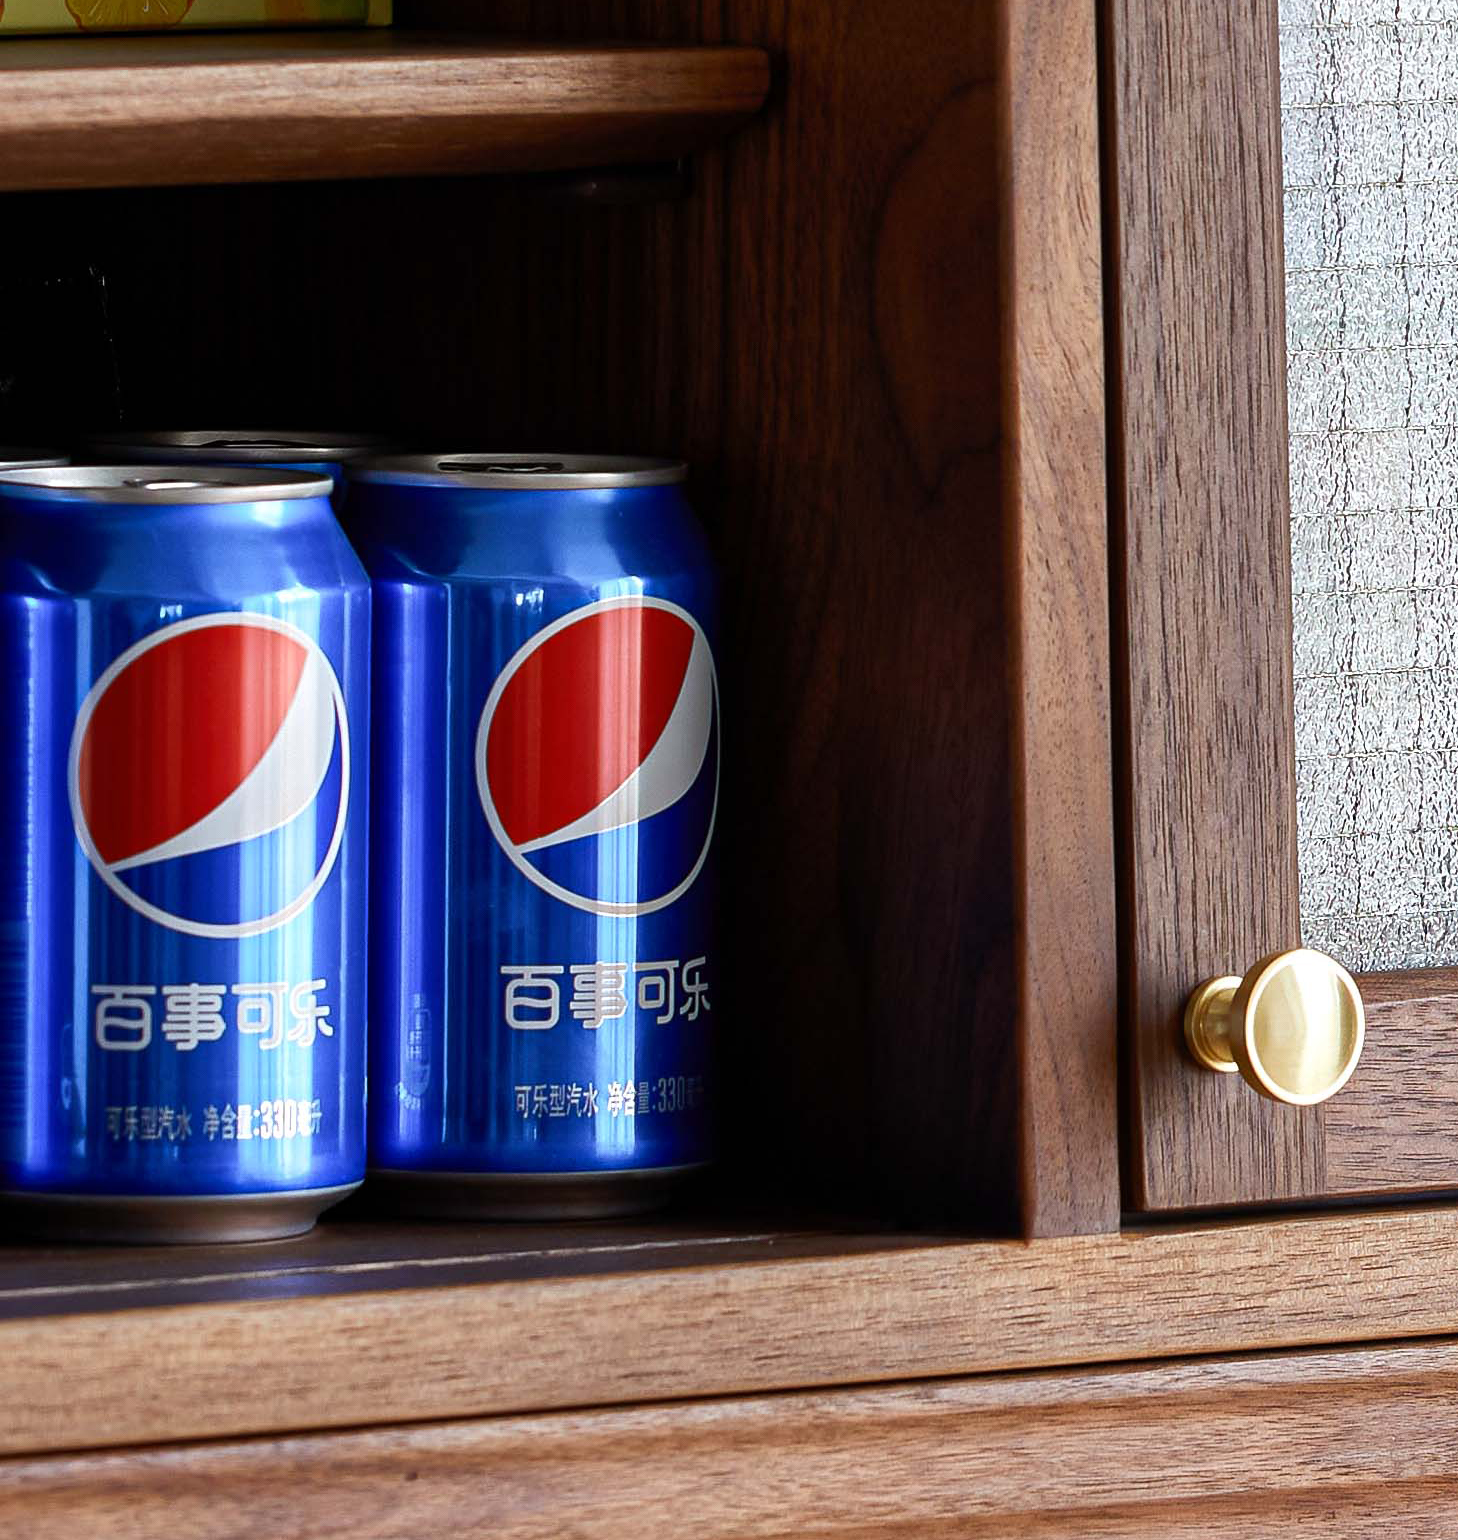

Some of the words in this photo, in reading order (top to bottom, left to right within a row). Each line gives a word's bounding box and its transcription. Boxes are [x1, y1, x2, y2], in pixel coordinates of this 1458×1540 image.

[91, 978, 334, 1051] 百事可乐
[500, 955, 711, 1030] 百事可乐
[105, 1105, 192, 1141] 可乐型汽水
[514, 1081, 599, 1119] 可乐型汽水
